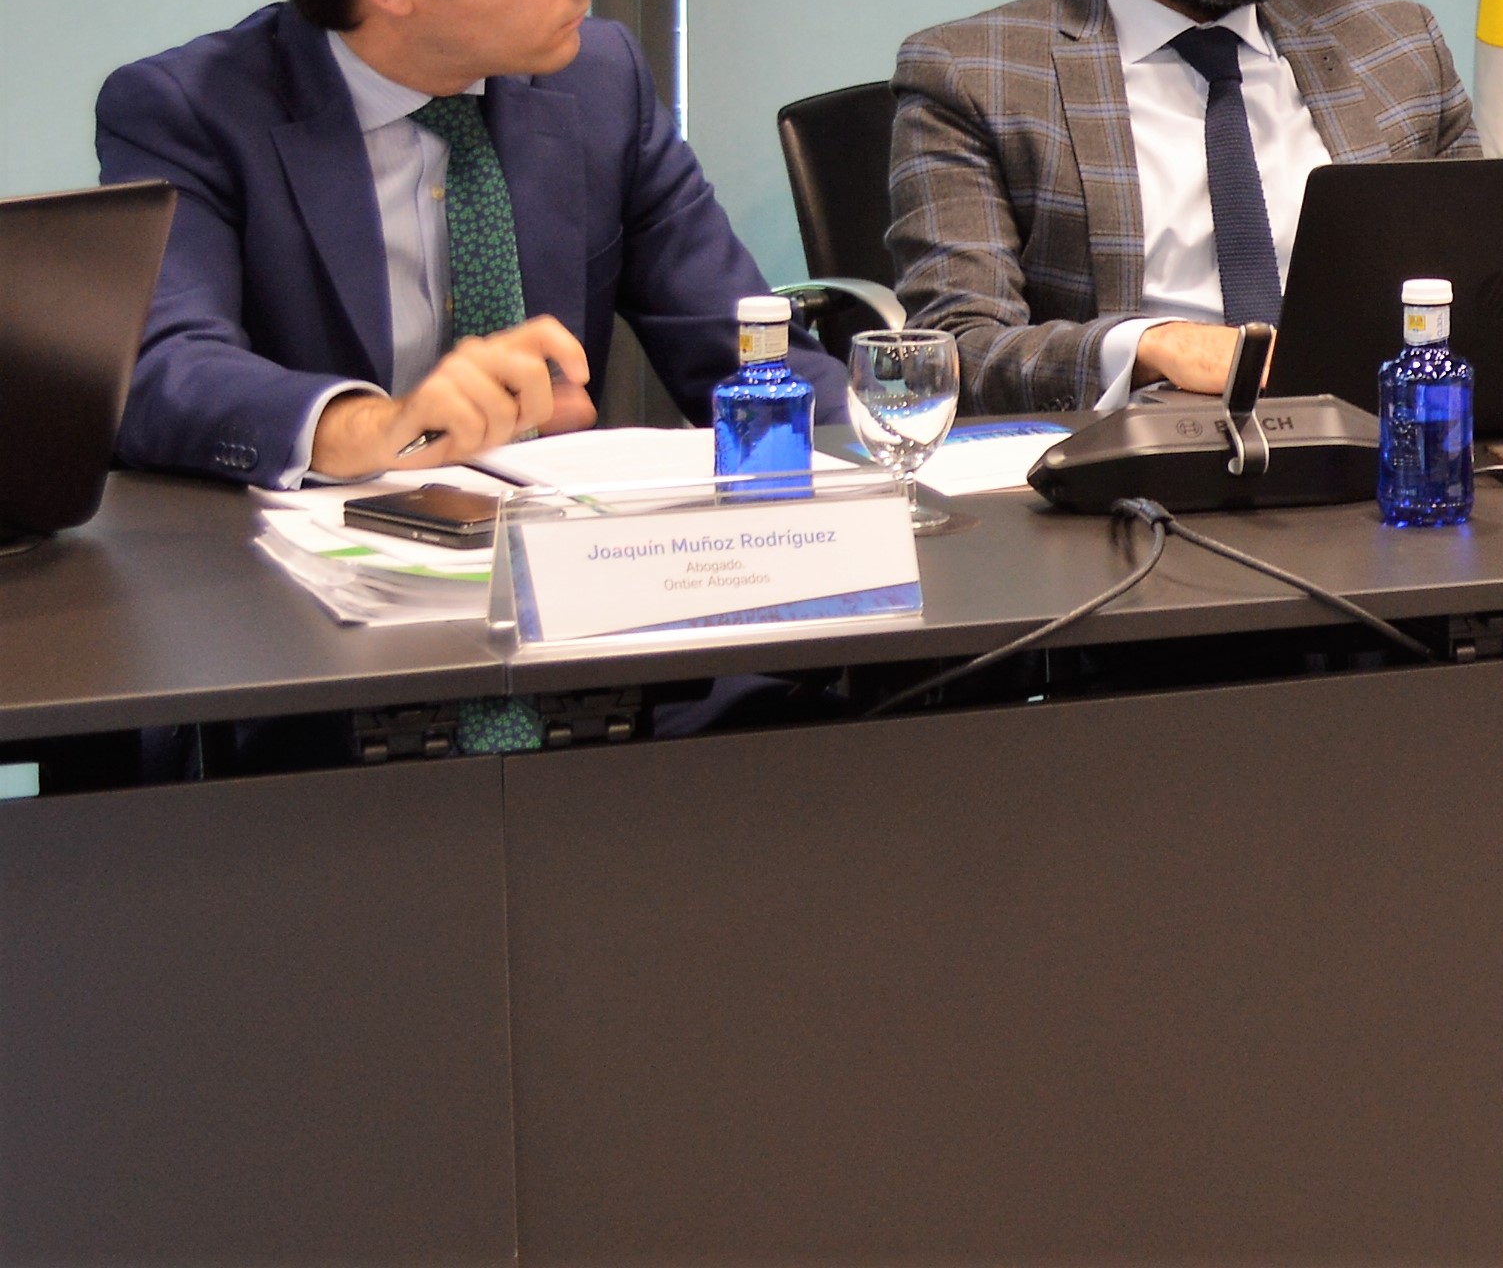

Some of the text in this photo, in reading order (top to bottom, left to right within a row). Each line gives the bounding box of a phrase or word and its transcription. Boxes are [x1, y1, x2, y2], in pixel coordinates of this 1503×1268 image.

[1214, 416, 1295, 431] BCH
[587, 529, 837, 560] Joaquín Muñoz Rodríguez
[686, 559, 746, 574] Abogado.
[664, 572, 771, 591] Ontier Abogados
